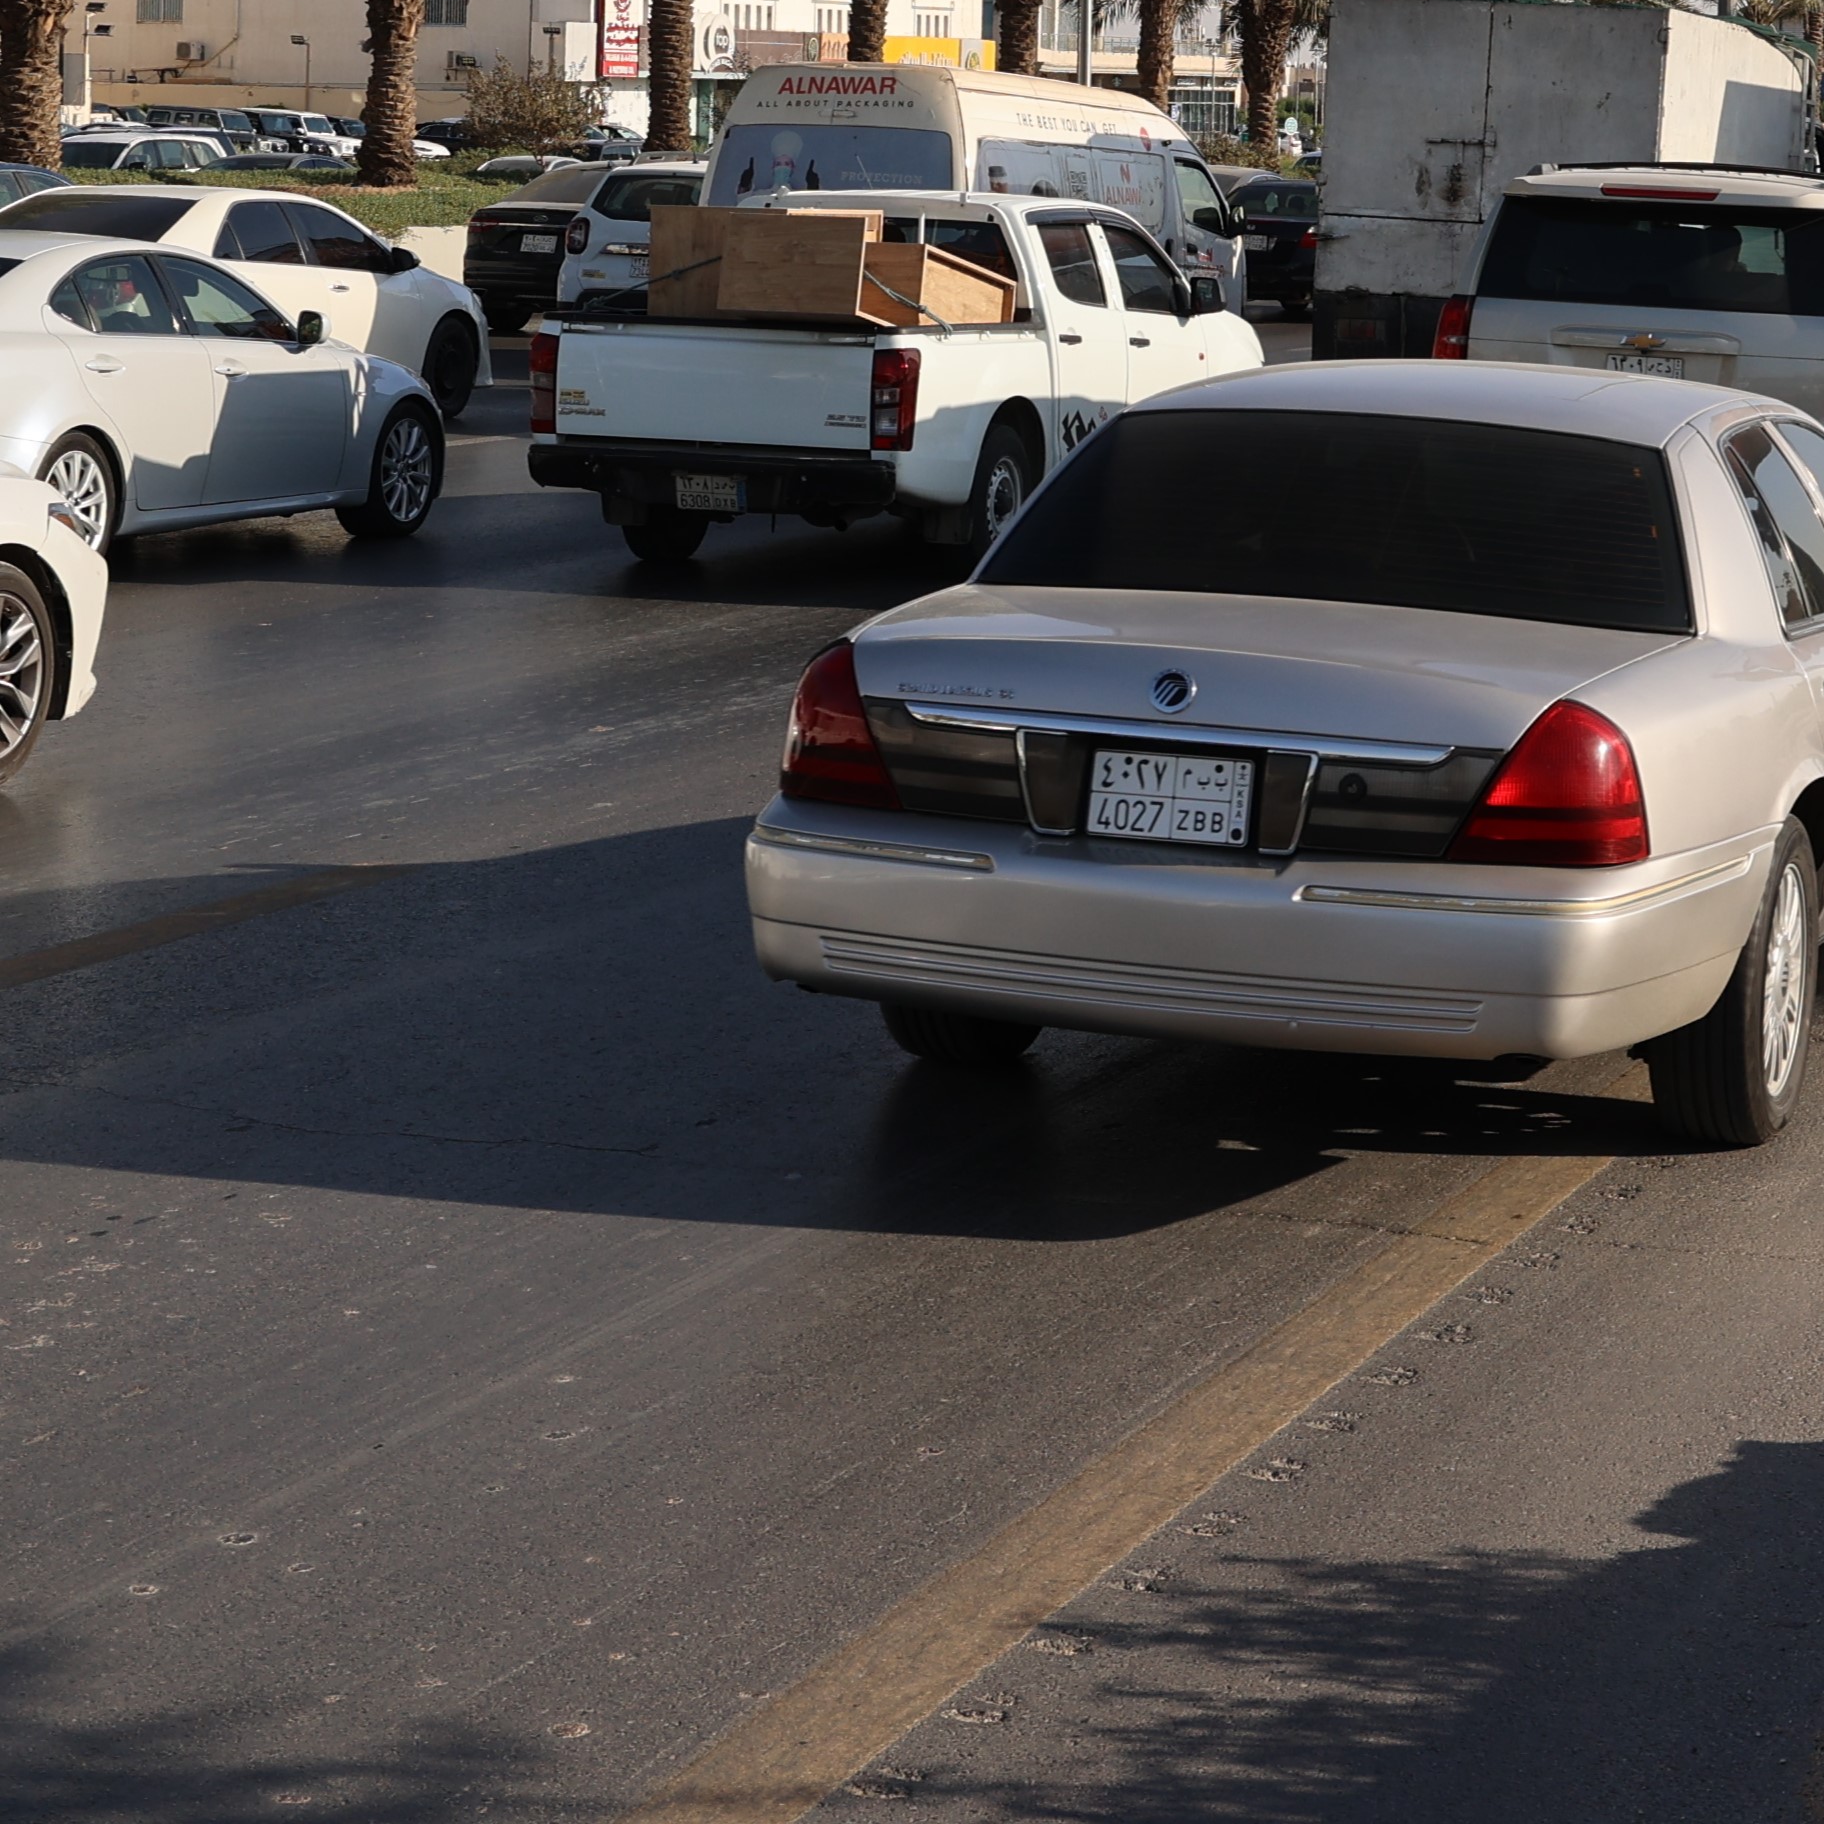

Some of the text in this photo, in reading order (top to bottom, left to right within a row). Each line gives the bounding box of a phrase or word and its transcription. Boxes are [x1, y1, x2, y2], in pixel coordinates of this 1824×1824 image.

[777, 76, 897, 95] ALNAWAR
[756, 99, 915, 109] ALL ABOUT PACKAGING
[1016, 112, 1118, 135] THE BEST YOU CAN GET
[840, 171, 923, 185] PROTECTION
[680, 493, 737, 509] 6308 DXB
[1101, 756, 1169, 792] ٤٠٢٧
[1097, 797, 1225, 834] 4027 ZBB
